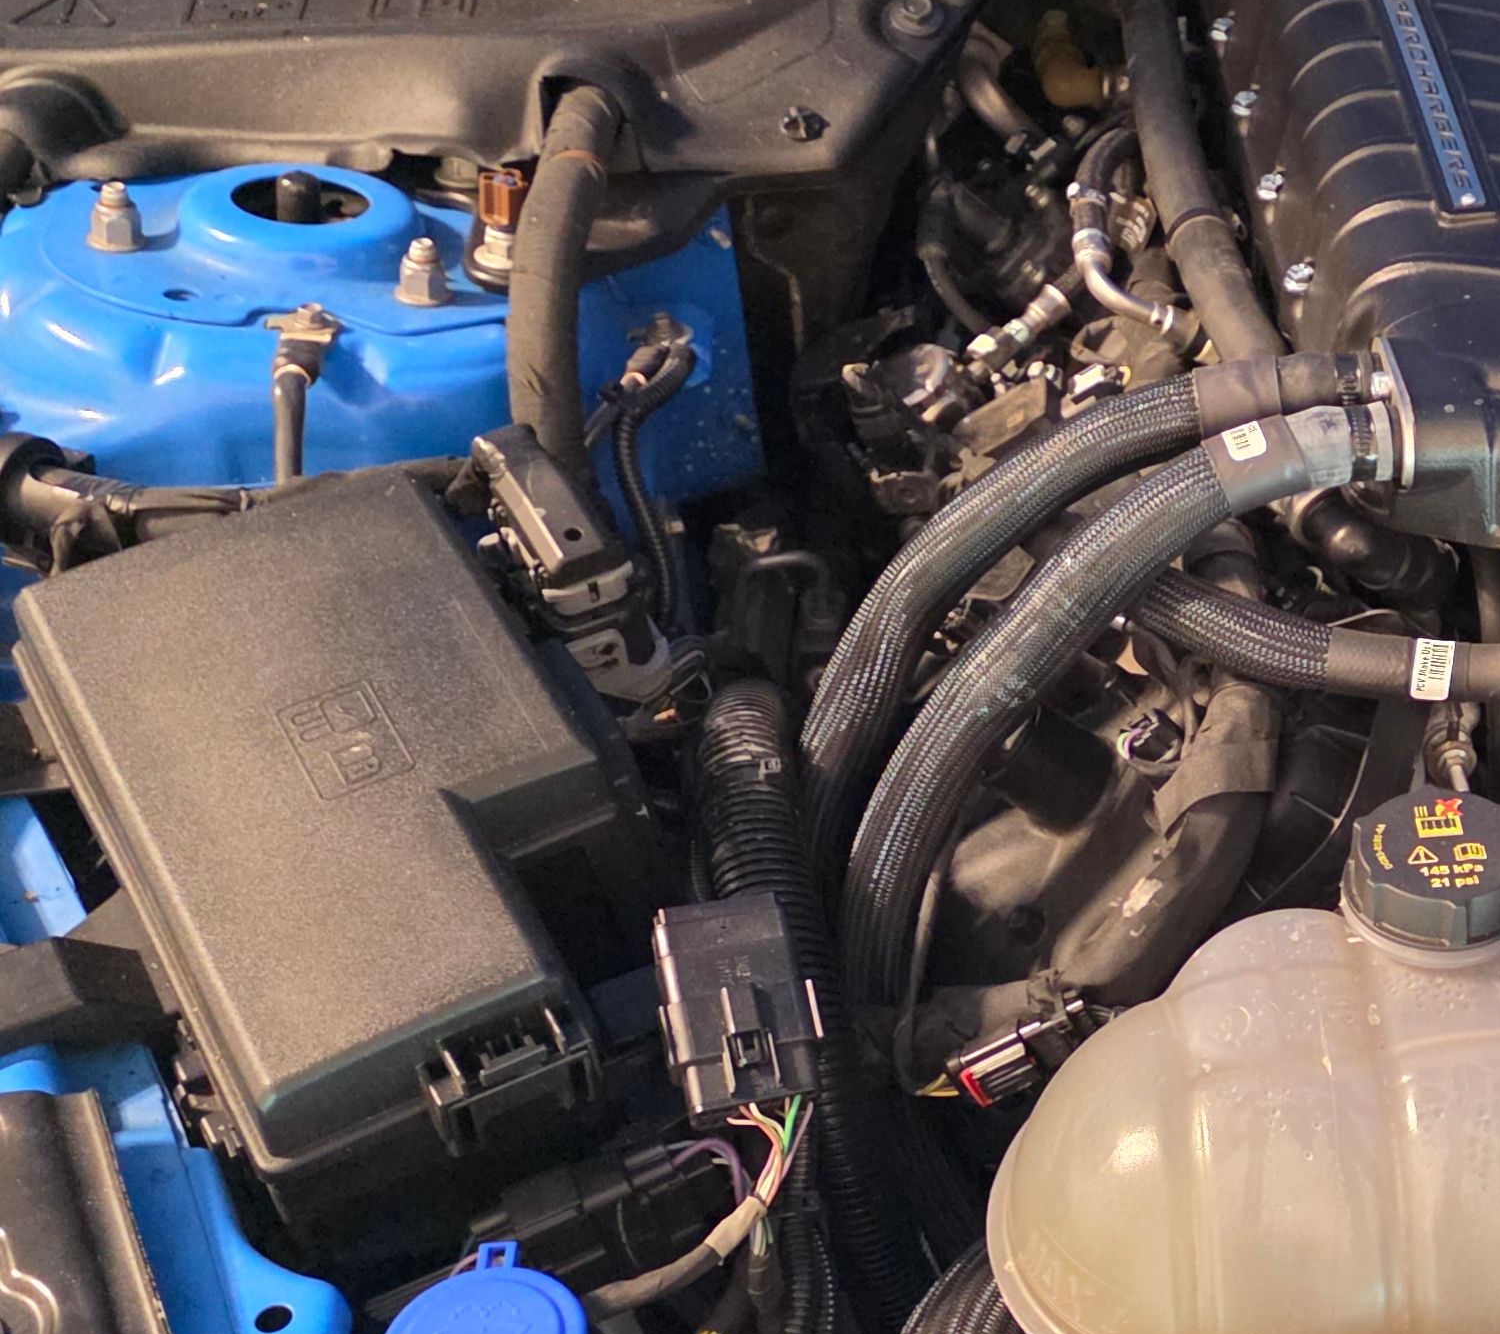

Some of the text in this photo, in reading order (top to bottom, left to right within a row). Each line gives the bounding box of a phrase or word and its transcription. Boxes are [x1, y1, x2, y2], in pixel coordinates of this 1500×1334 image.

[1420, 863, 1484, 877] 145 kPa
[1430, 875, 1480, 888] 21 psi
